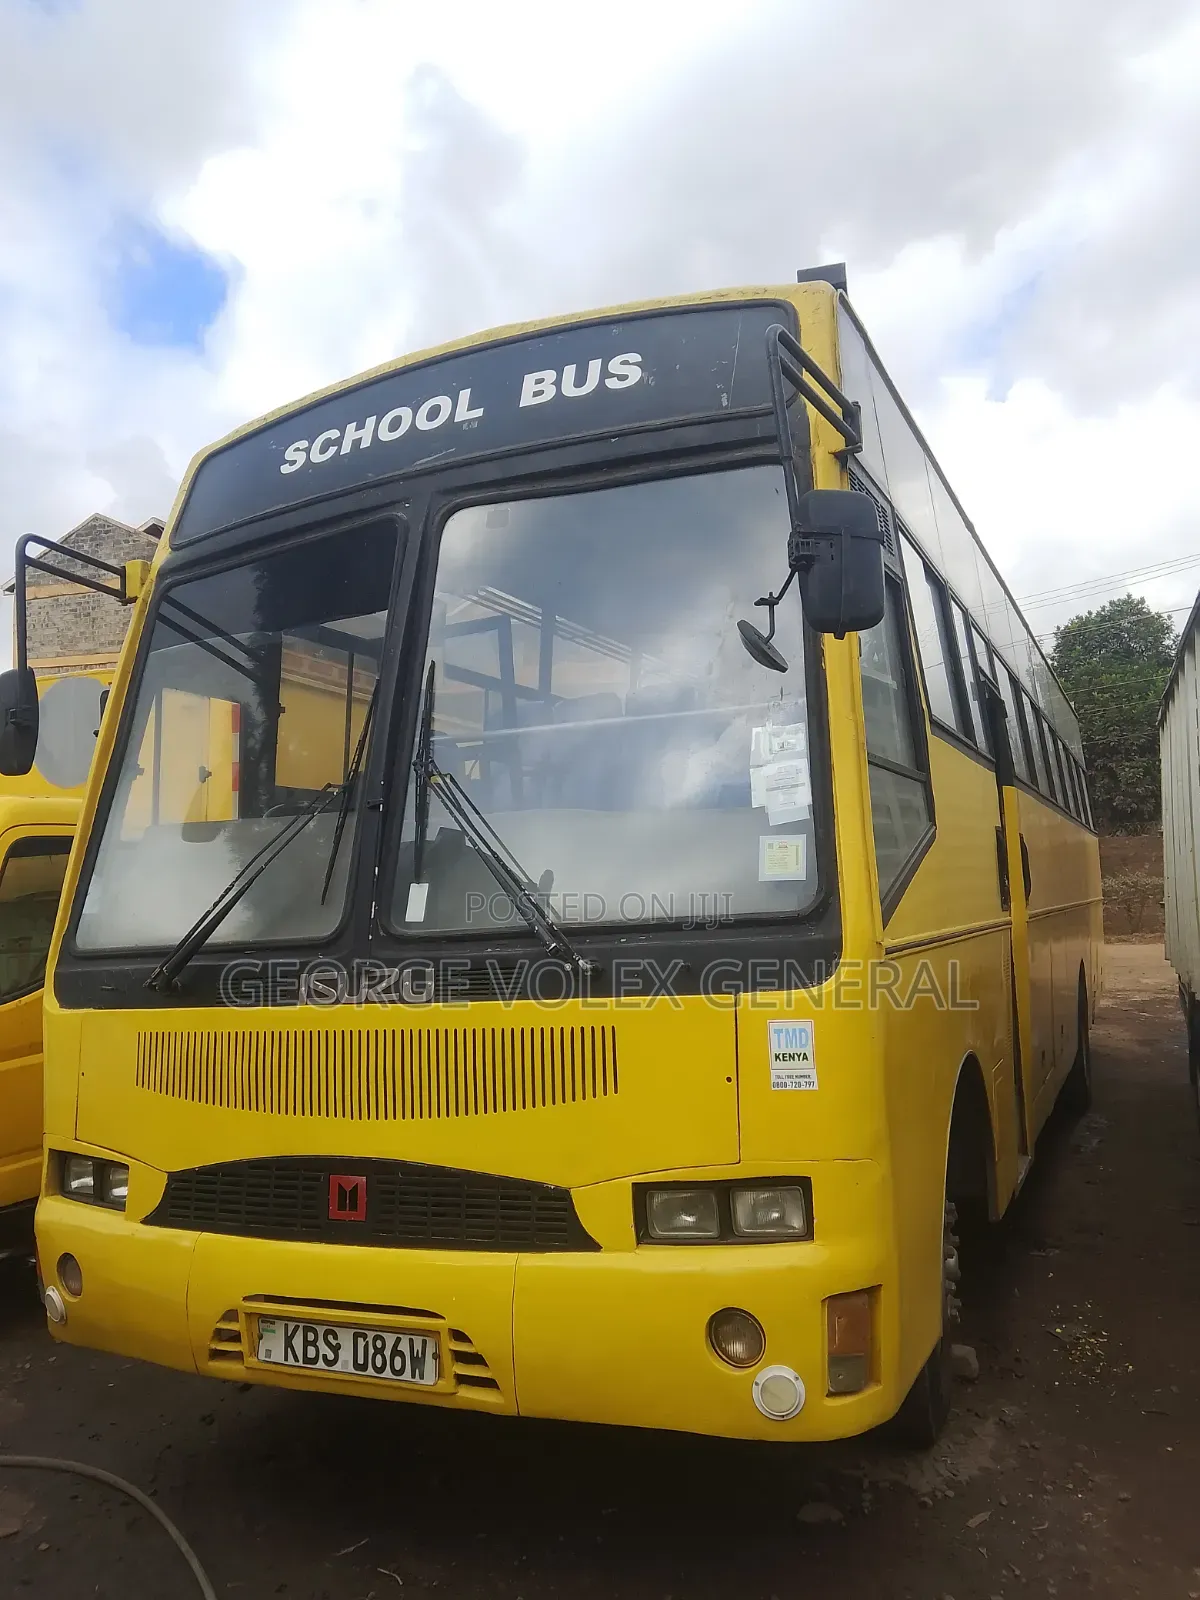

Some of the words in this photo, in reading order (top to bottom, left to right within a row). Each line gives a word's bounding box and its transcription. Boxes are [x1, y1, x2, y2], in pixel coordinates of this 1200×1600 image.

[280, 387, 484, 475] SCHOOL
[518, 352, 643, 408] BUS
[298, 967, 435, 1005] ISUZU
[773, 1028, 809, 1049] TMD
[774, 1052, 809, 1061] KENYA
[772, 1081, 815, 1089] 0800-720-797
[283, 1323, 341, 1368] KBS
[352, 1331, 428, 1381] 086W
